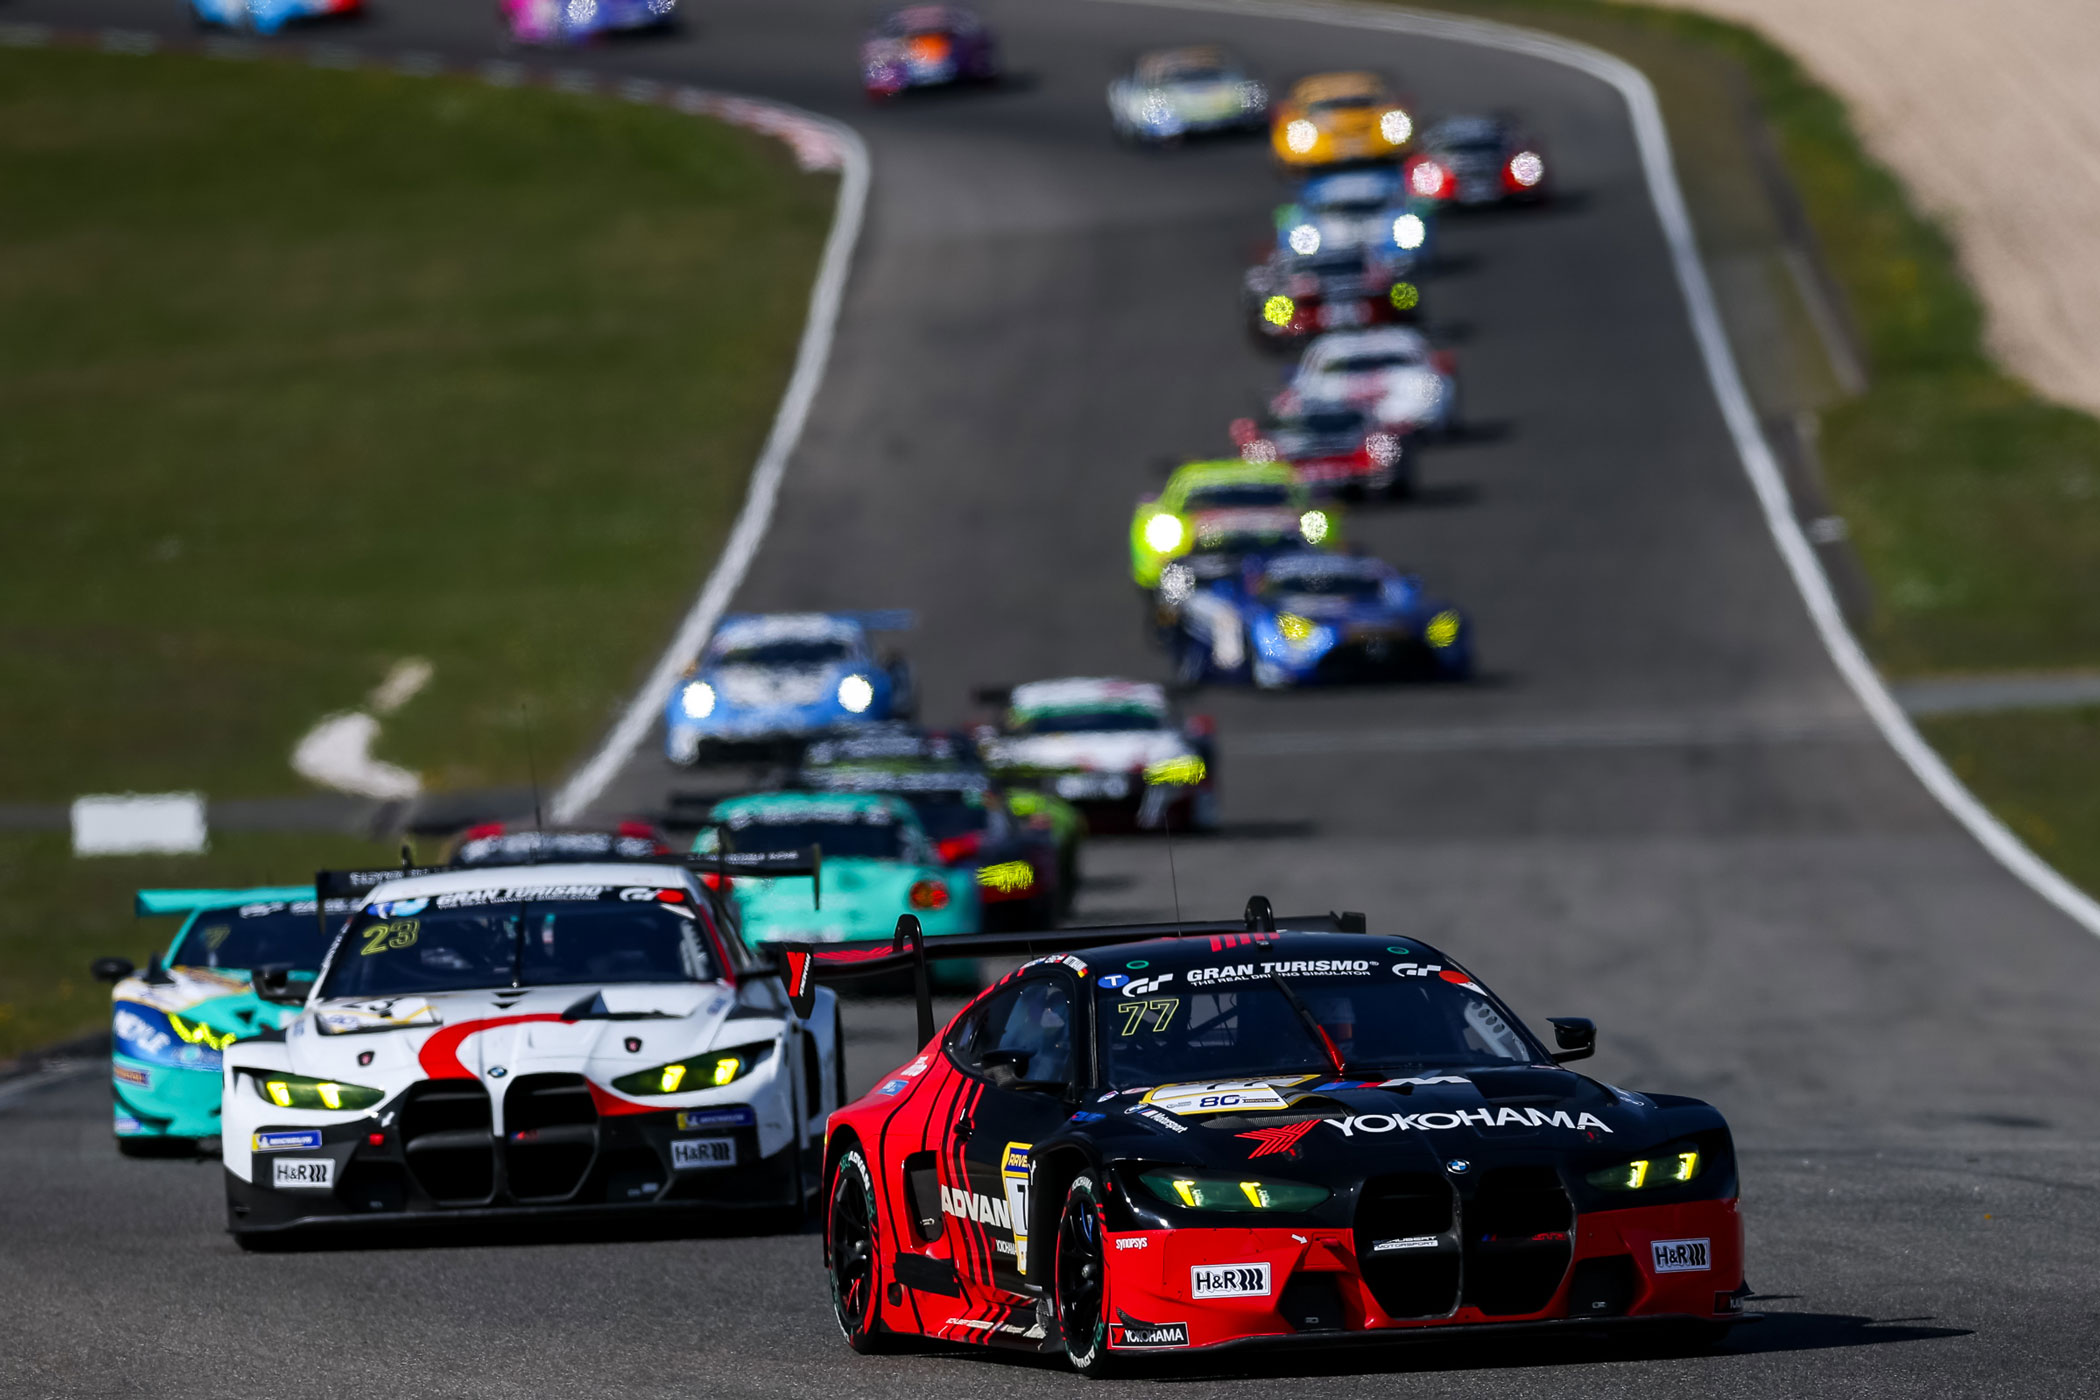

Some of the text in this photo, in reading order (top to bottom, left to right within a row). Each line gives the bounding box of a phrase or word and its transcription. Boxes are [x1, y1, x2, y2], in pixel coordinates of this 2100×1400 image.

[360, 918, 421, 956] 23
[1187, 960, 1369, 982] GRAN TURISMO
[1190, 979, 1215, 987] THE
[1217, 975, 1249, 984] REAL
[1251, 971, 1300, 981] DRING
[1118, 998, 1179, 1037] 77
[1323, 1107, 1614, 1137] YOKOHAMA
[674, 1143, 710, 1163] H&R
[1008, 1153, 1029, 1168] RAVE
[277, 1164, 307, 1180] H&R
[941, 1184, 1012, 1230] ADVAN
[1655, 1244, 1687, 1265] H&R
[1196, 1270, 1237, 1291] H&R
[1124, 1327, 1185, 1343] YOKOHAMA
